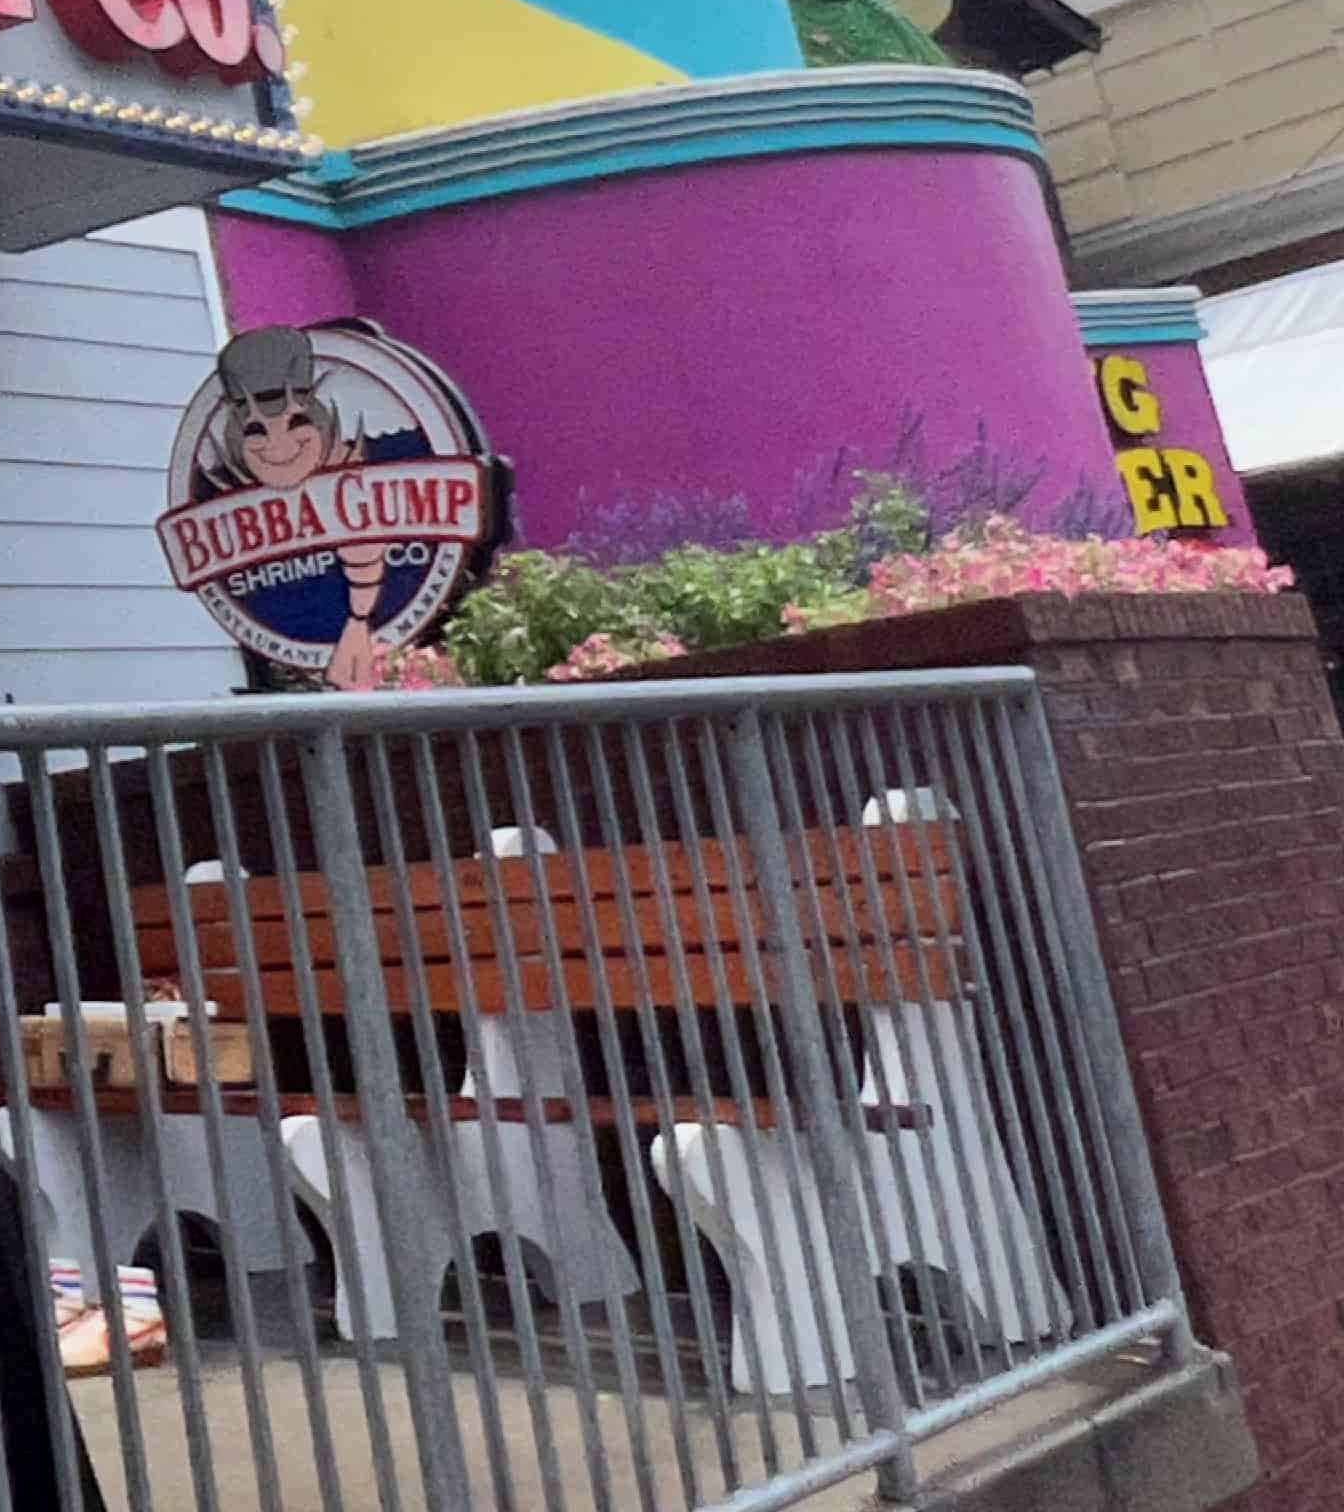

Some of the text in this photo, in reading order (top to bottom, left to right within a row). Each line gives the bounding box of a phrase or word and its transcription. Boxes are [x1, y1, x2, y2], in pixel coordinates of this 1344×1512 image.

[173, 472, 474, 576] BUBBA GUMP
[227, 541, 431, 596] SHRIMP CO
